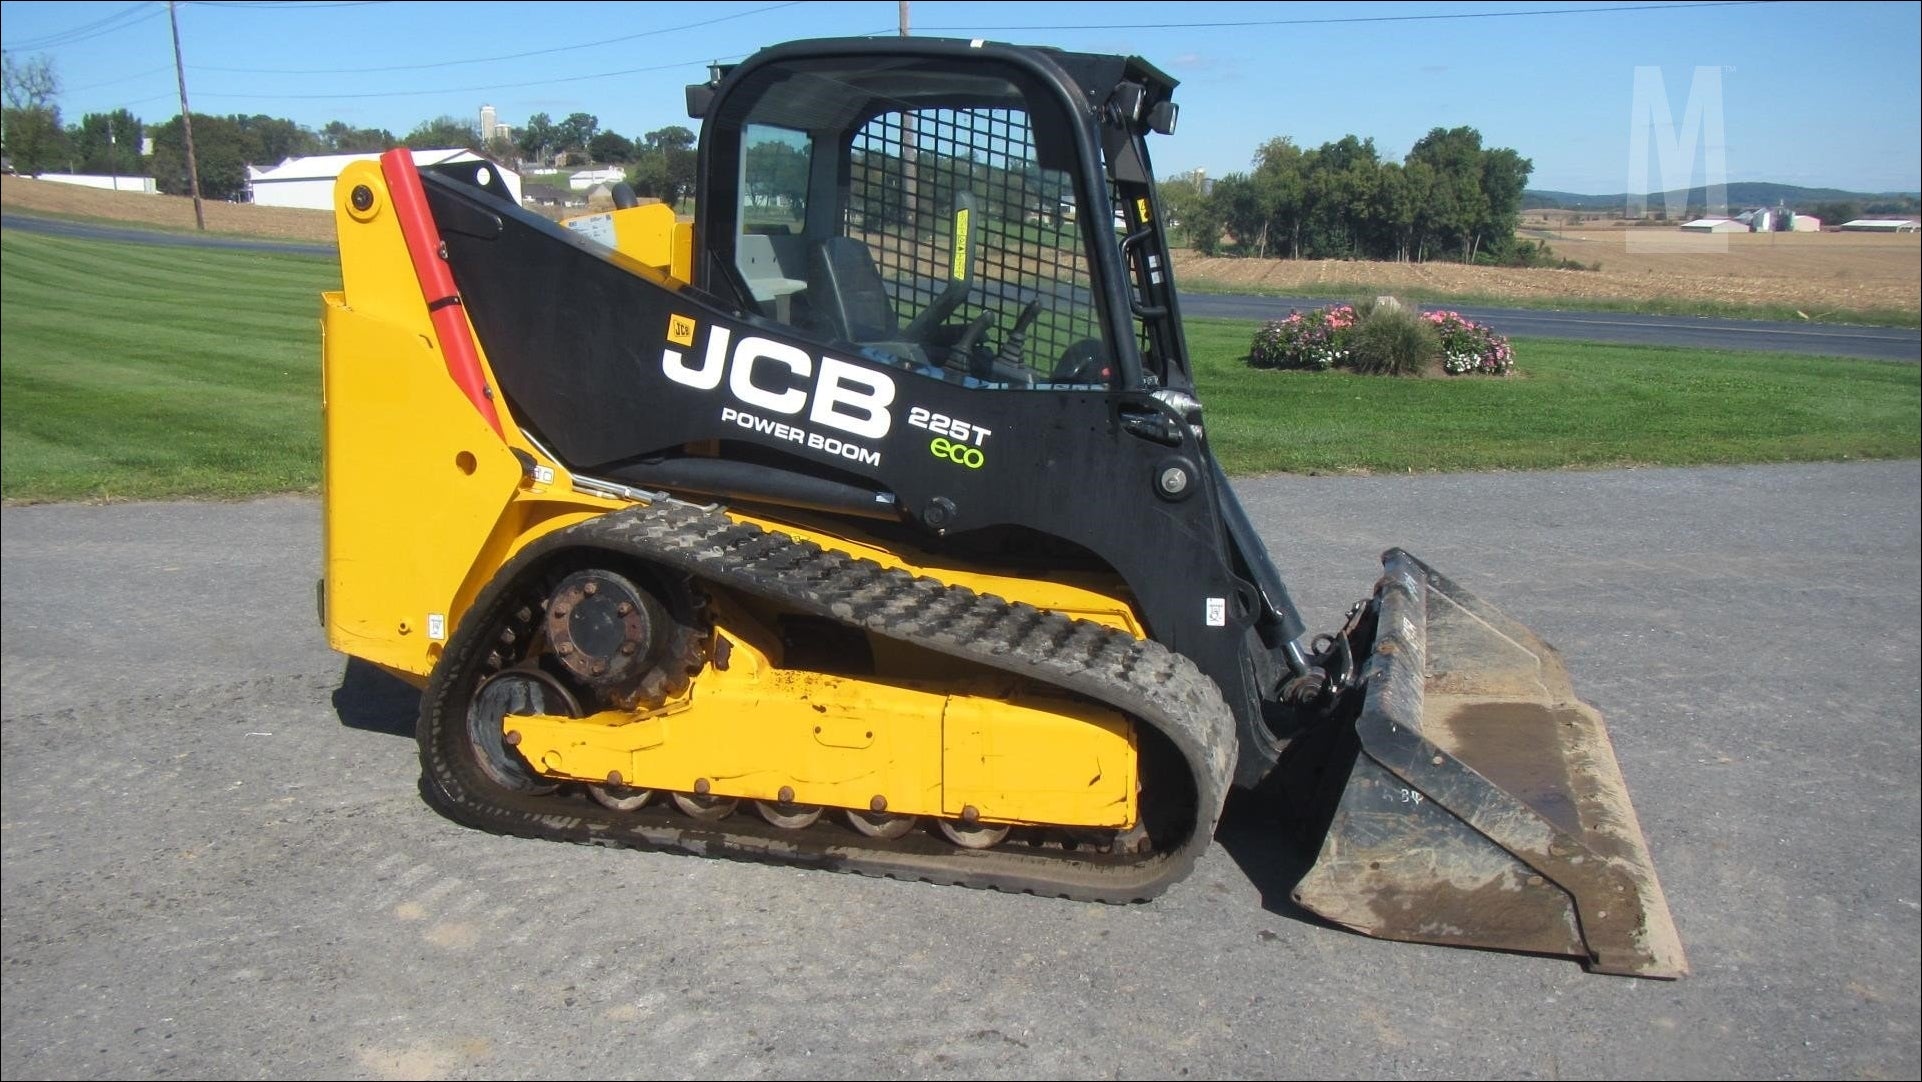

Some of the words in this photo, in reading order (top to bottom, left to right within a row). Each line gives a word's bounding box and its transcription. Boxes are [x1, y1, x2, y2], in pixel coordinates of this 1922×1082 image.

[675, 321, 689, 336] JCB
[662, 324, 896, 439] JCB
[721, 407, 805, 443] POWER
[807, 436, 881, 467] BOOM
[908, 406, 992, 446] 225T
[930, 437, 985, 469] eco
